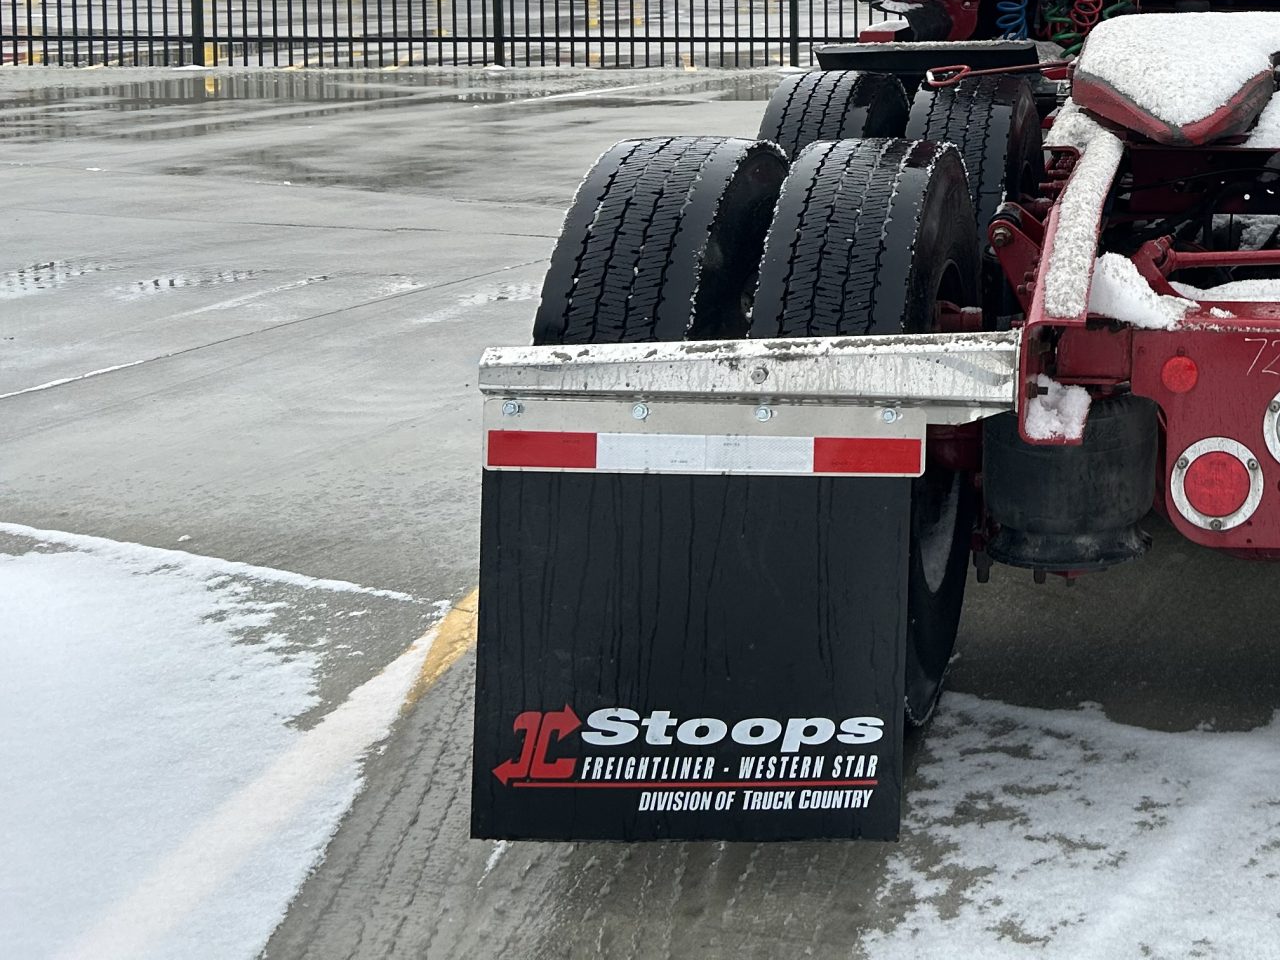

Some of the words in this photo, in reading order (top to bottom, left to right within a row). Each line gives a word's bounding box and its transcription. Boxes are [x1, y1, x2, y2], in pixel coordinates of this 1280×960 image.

[582, 708, 885, 752] Stoops
[582, 757, 714, 780] FREIGHTLINER
[739, 756, 824, 779] WESTERN
[832, 755, 878, 779] STAR
[639, 792, 712, 811] DIVISION
[715, 791, 735, 810] OF
[743, 791, 795, 810] TRUCK
[799, 790, 873, 809] COUNTRY
